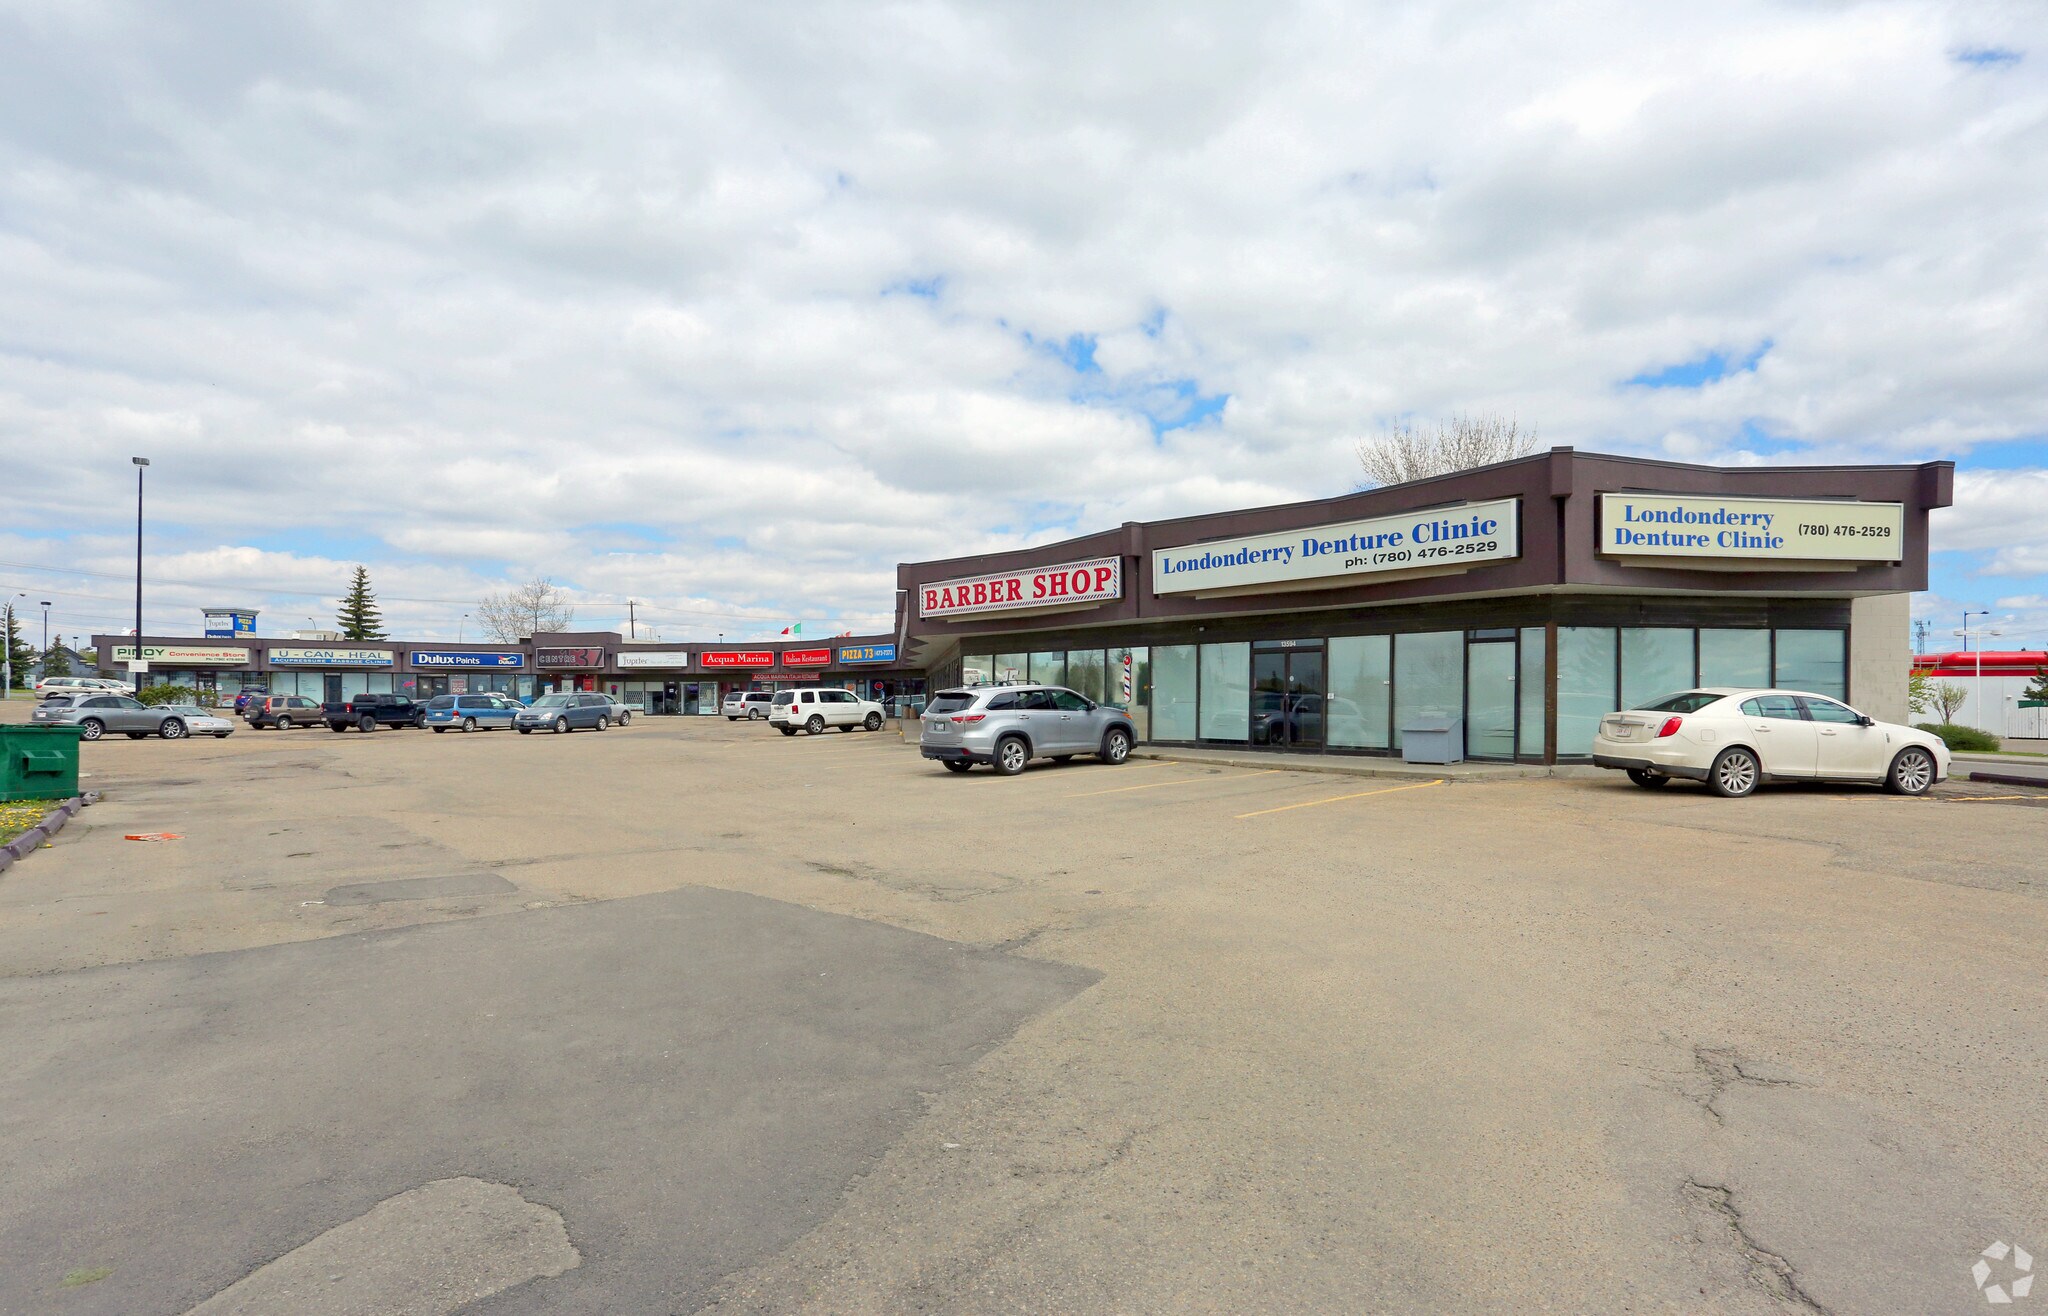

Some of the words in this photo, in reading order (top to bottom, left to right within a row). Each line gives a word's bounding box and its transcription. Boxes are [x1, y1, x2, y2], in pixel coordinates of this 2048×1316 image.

[1624, 505, 1775, 530] Londonderry
[1798, 523, 1829, 537] (780)
[1833, 526, 1891, 537] 476-2529
[1163, 546, 1296, 574] Londonderry
[1301, 531, 1404, 557] Denture
[1412, 515, 1498, 544] Clinic
[1614, 527, 1710, 547] Denture
[1717, 530, 1784, 549] Clinic
[1345, 557, 1368, 568] ph:
[1373, 550, 1412, 565] (780)
[1417, 541, 1498, 559] 476-2529
[924, 578, 1023, 610] BARBER
[1033, 567, 1112, 599] SHOP
[418, 653, 454, 664] Dulux
[455, 656, 480, 664] Paints
[538, 655, 576, 663] CENTRE
[706, 653, 734, 664] Acqua
[738, 653, 769, 662] Marina
[786, 655, 800, 663] Italian
[802, 654, 828, 662] Restaurant
[842, 649, 863, 659] PIZZA
[864, 648, 874, 658] 73
